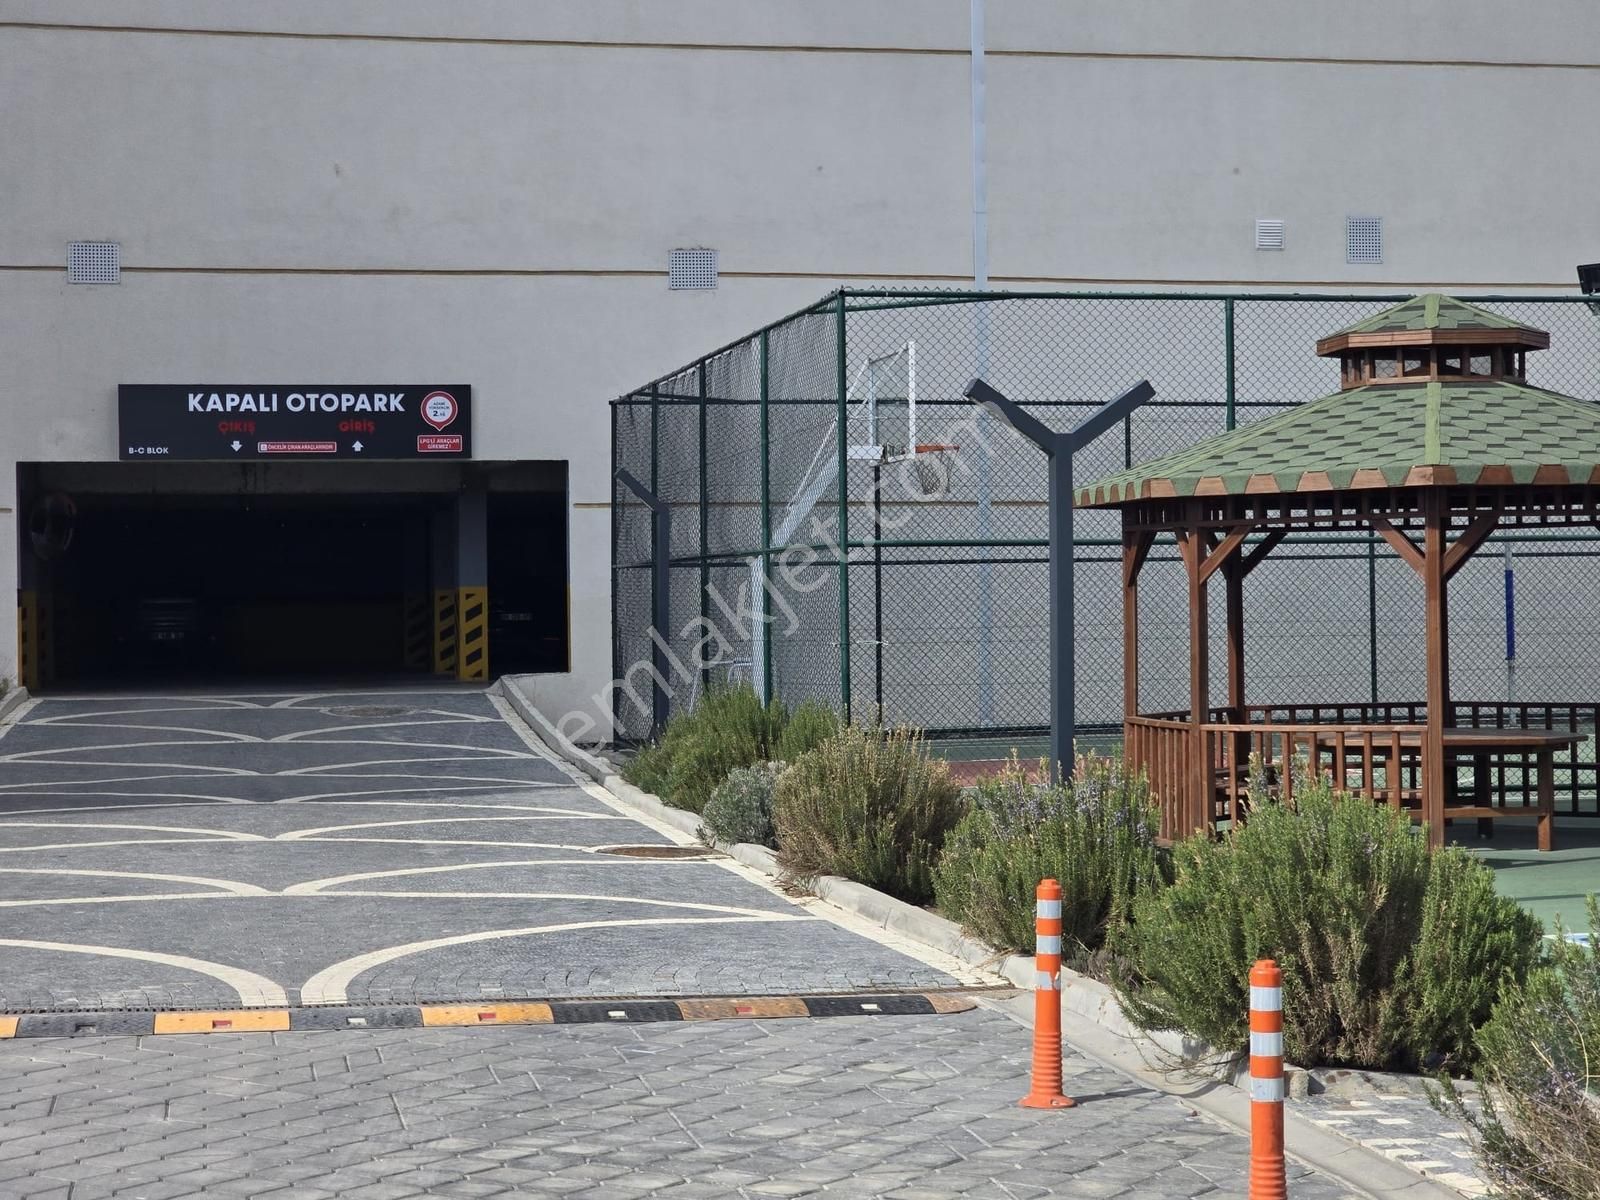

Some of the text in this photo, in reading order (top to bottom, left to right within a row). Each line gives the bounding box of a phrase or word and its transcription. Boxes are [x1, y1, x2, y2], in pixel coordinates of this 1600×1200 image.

[188, 393, 405, 412] KAPALI OTOPARK
[218, 420, 256, 434] ÇIKIŞ
[338, 419, 376, 434] GİRİŞ
